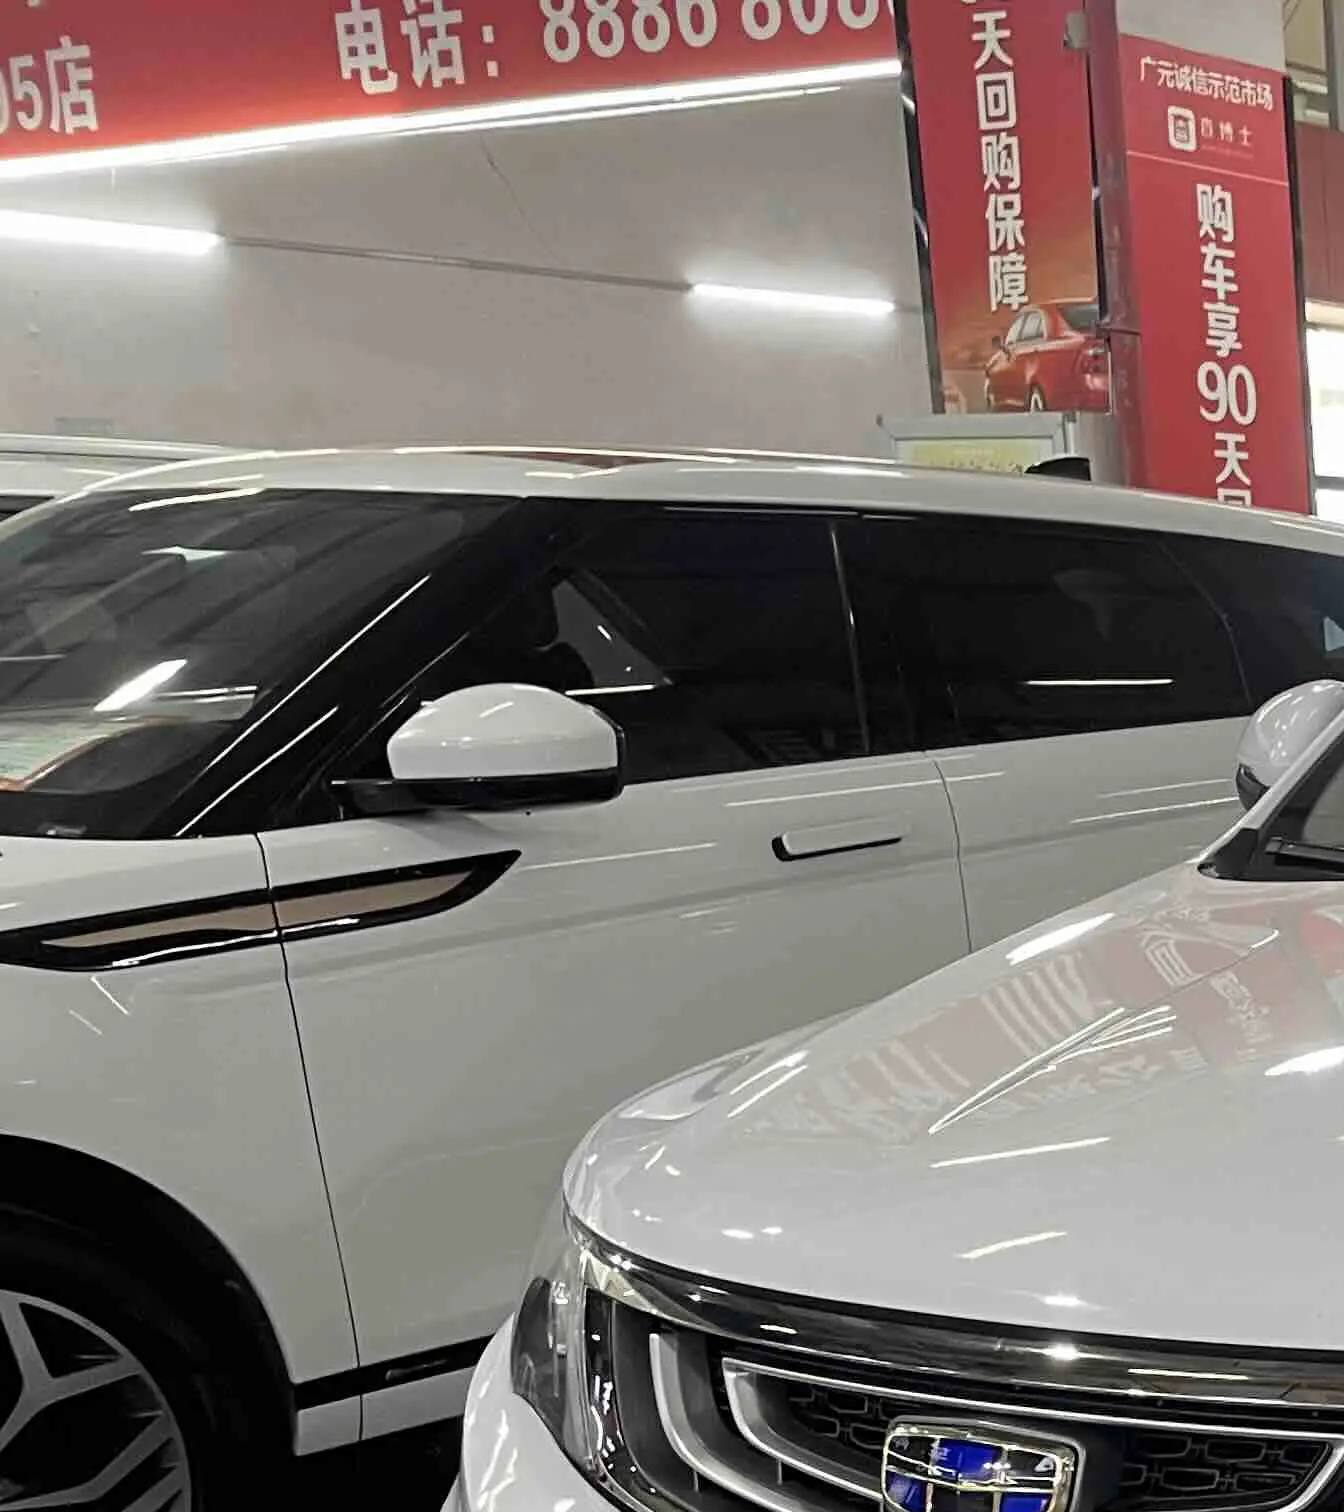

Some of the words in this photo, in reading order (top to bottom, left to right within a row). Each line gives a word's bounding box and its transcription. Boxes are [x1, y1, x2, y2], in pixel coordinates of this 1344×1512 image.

[1139, 56, 1273, 111] 广元诚信示范市场
